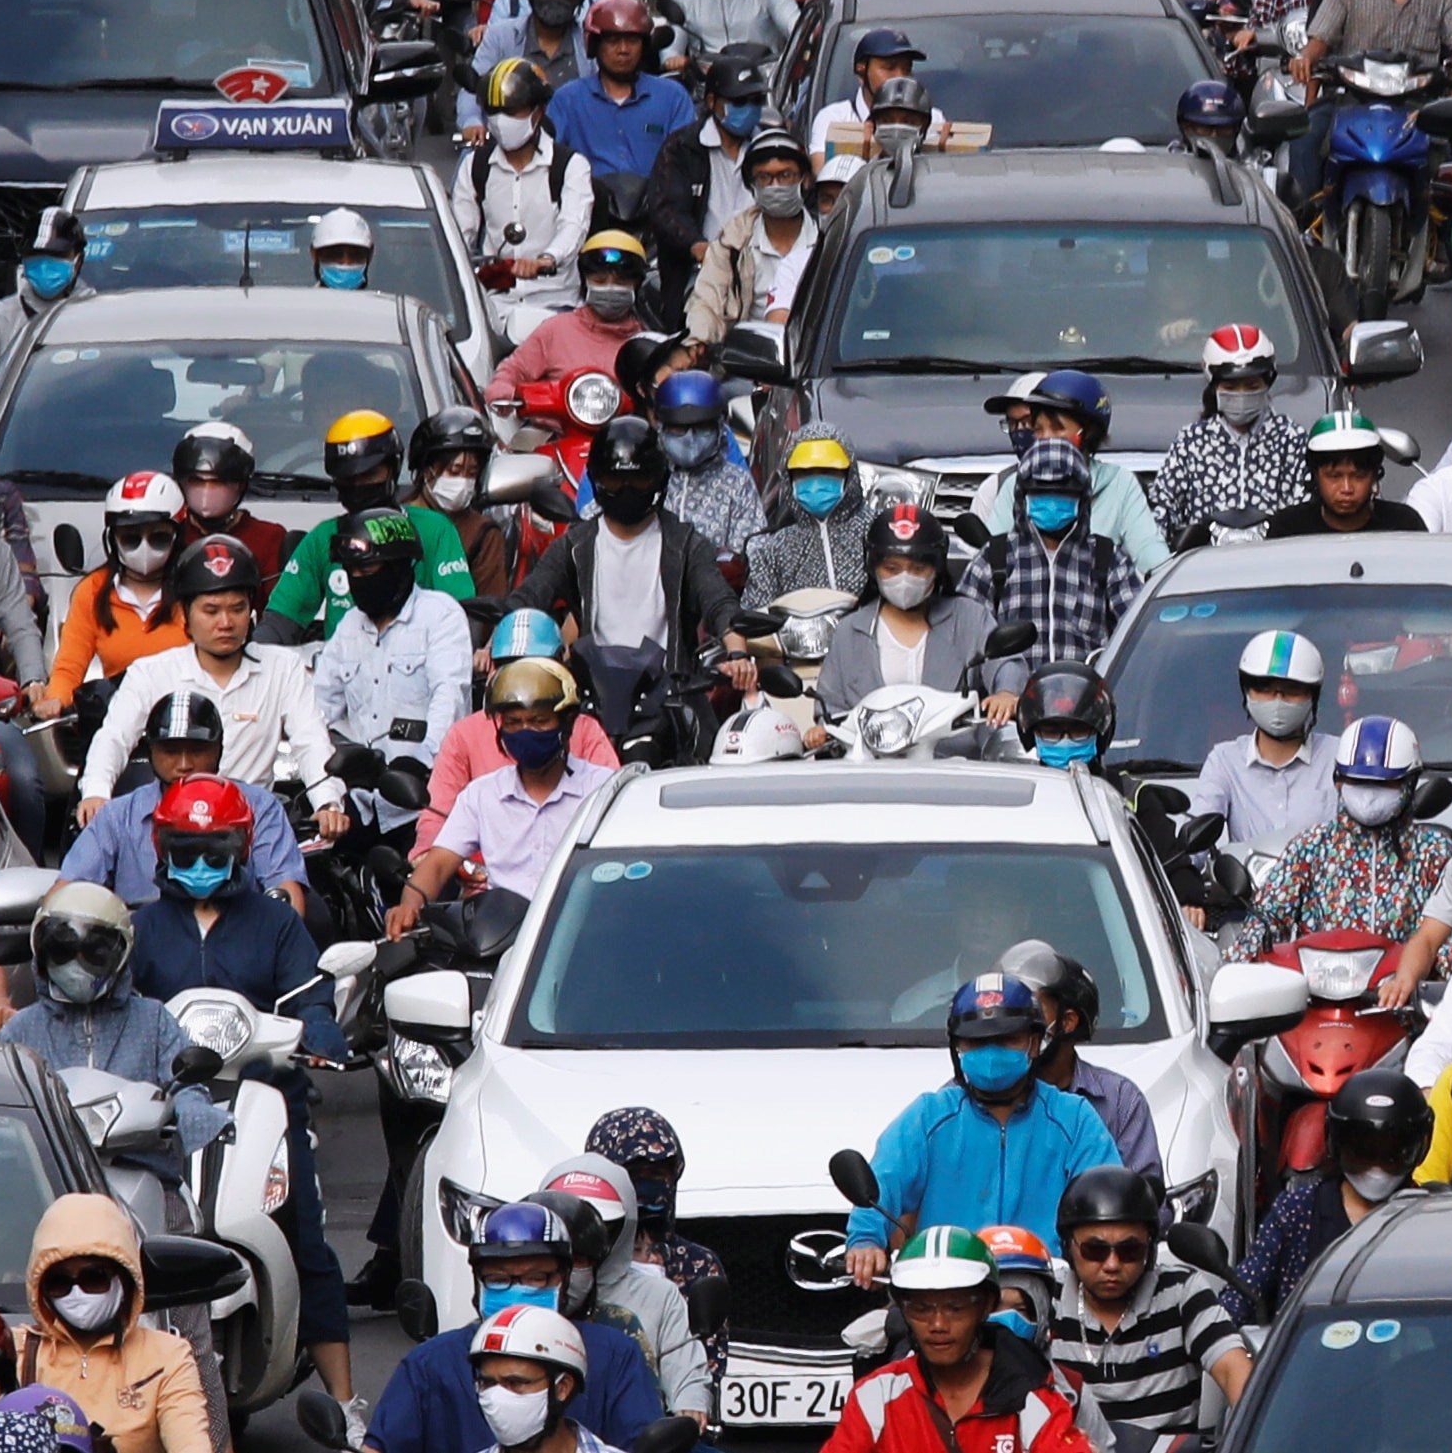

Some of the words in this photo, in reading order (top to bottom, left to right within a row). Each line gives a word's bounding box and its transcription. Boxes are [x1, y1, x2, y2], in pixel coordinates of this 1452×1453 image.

[222, 117, 267, 140] VẠN
[271, 112, 333, 136] XUÂN
[438, 558, 470, 577] Grab
[1318, 1020, 1355, 1029] HONDA
